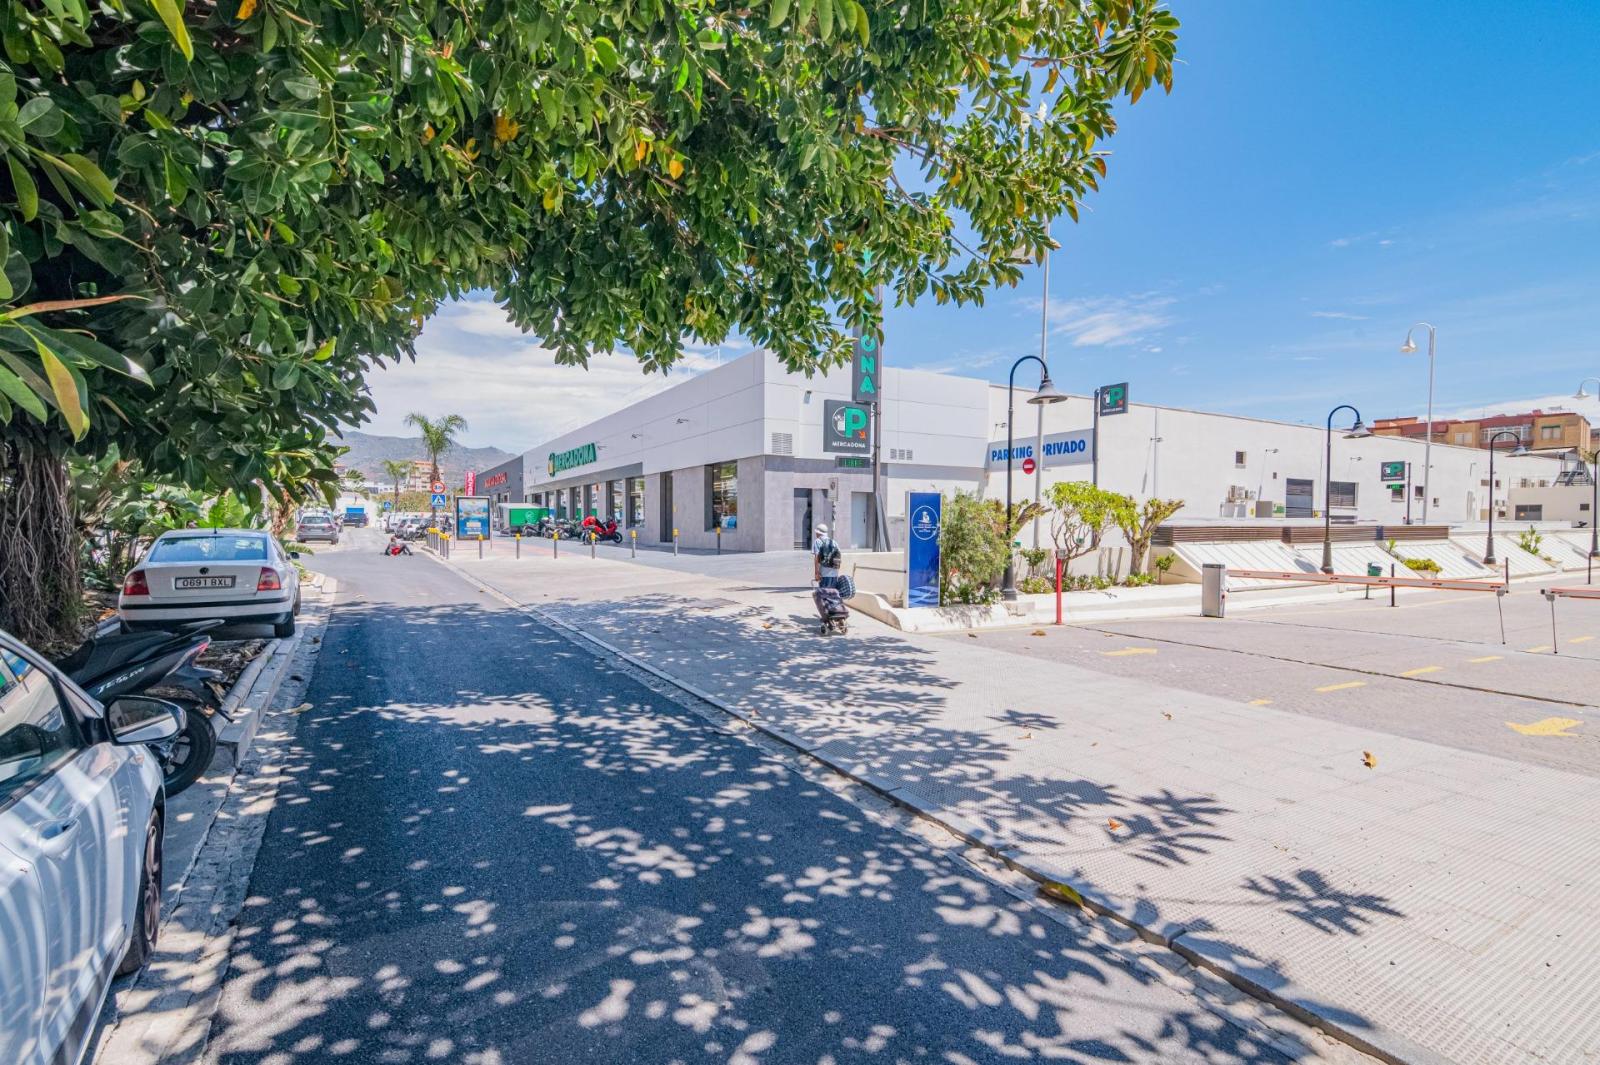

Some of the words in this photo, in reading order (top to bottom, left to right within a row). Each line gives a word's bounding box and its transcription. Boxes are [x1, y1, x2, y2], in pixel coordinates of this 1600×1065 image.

[845, 408, 867, 438] P
[554, 443, 597, 472] MERCADONA
[182, 579, 207, 587] 0691
[210, 578, 230, 586] BXL
